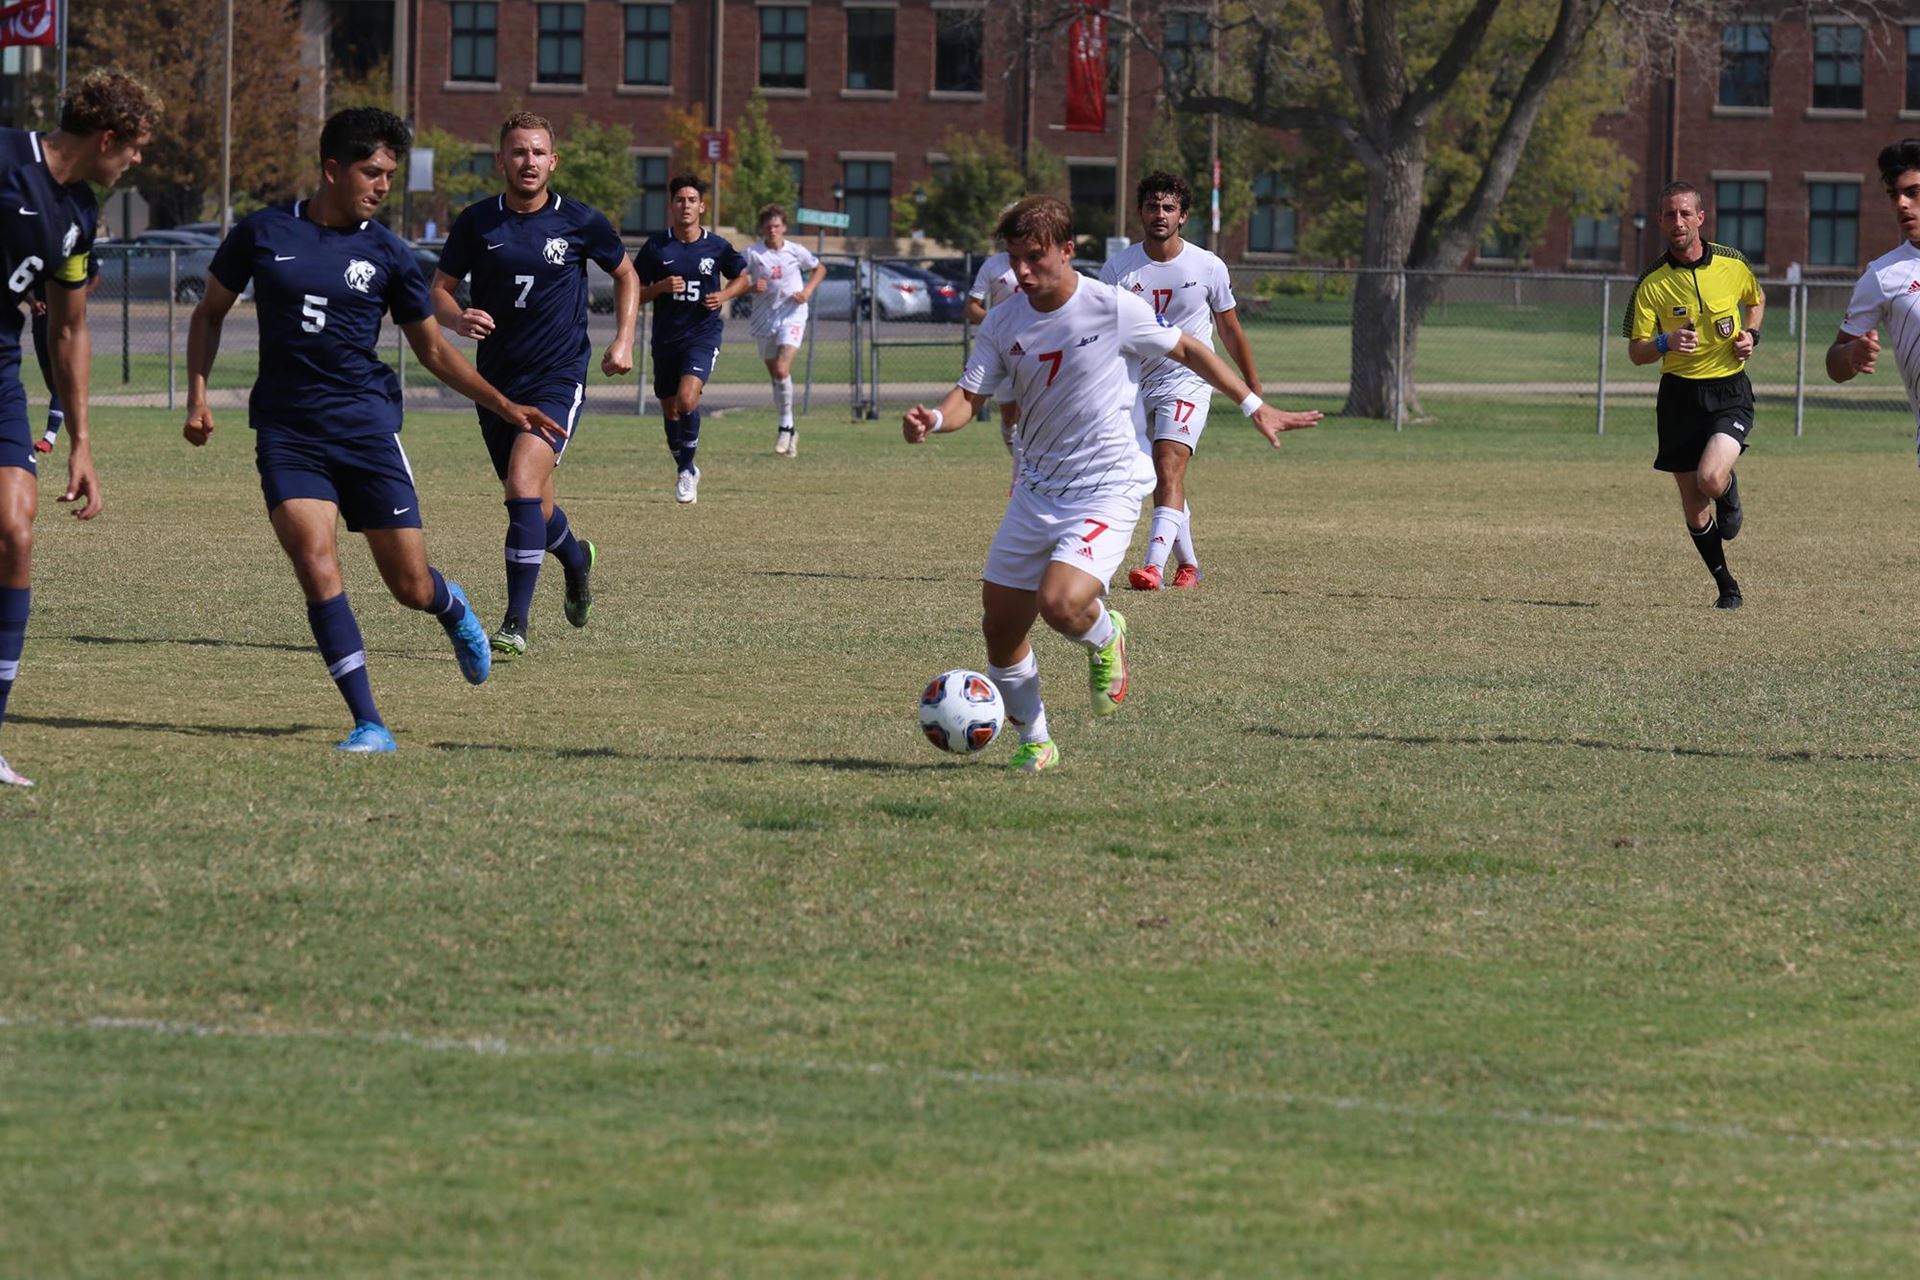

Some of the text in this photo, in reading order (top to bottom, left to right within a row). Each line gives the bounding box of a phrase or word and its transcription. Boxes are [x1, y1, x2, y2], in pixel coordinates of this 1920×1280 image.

[708, 140, 721, 158] E
[8, 255, 44, 293] 6
[515, 275, 535, 308] 7
[1152, 287, 1174, 314] 17
[301, 294, 328, 333] 5
[1038, 350, 1063, 387] 7
[1174, 399, 1195, 423] 17
[1081, 518, 1108, 543] 7
